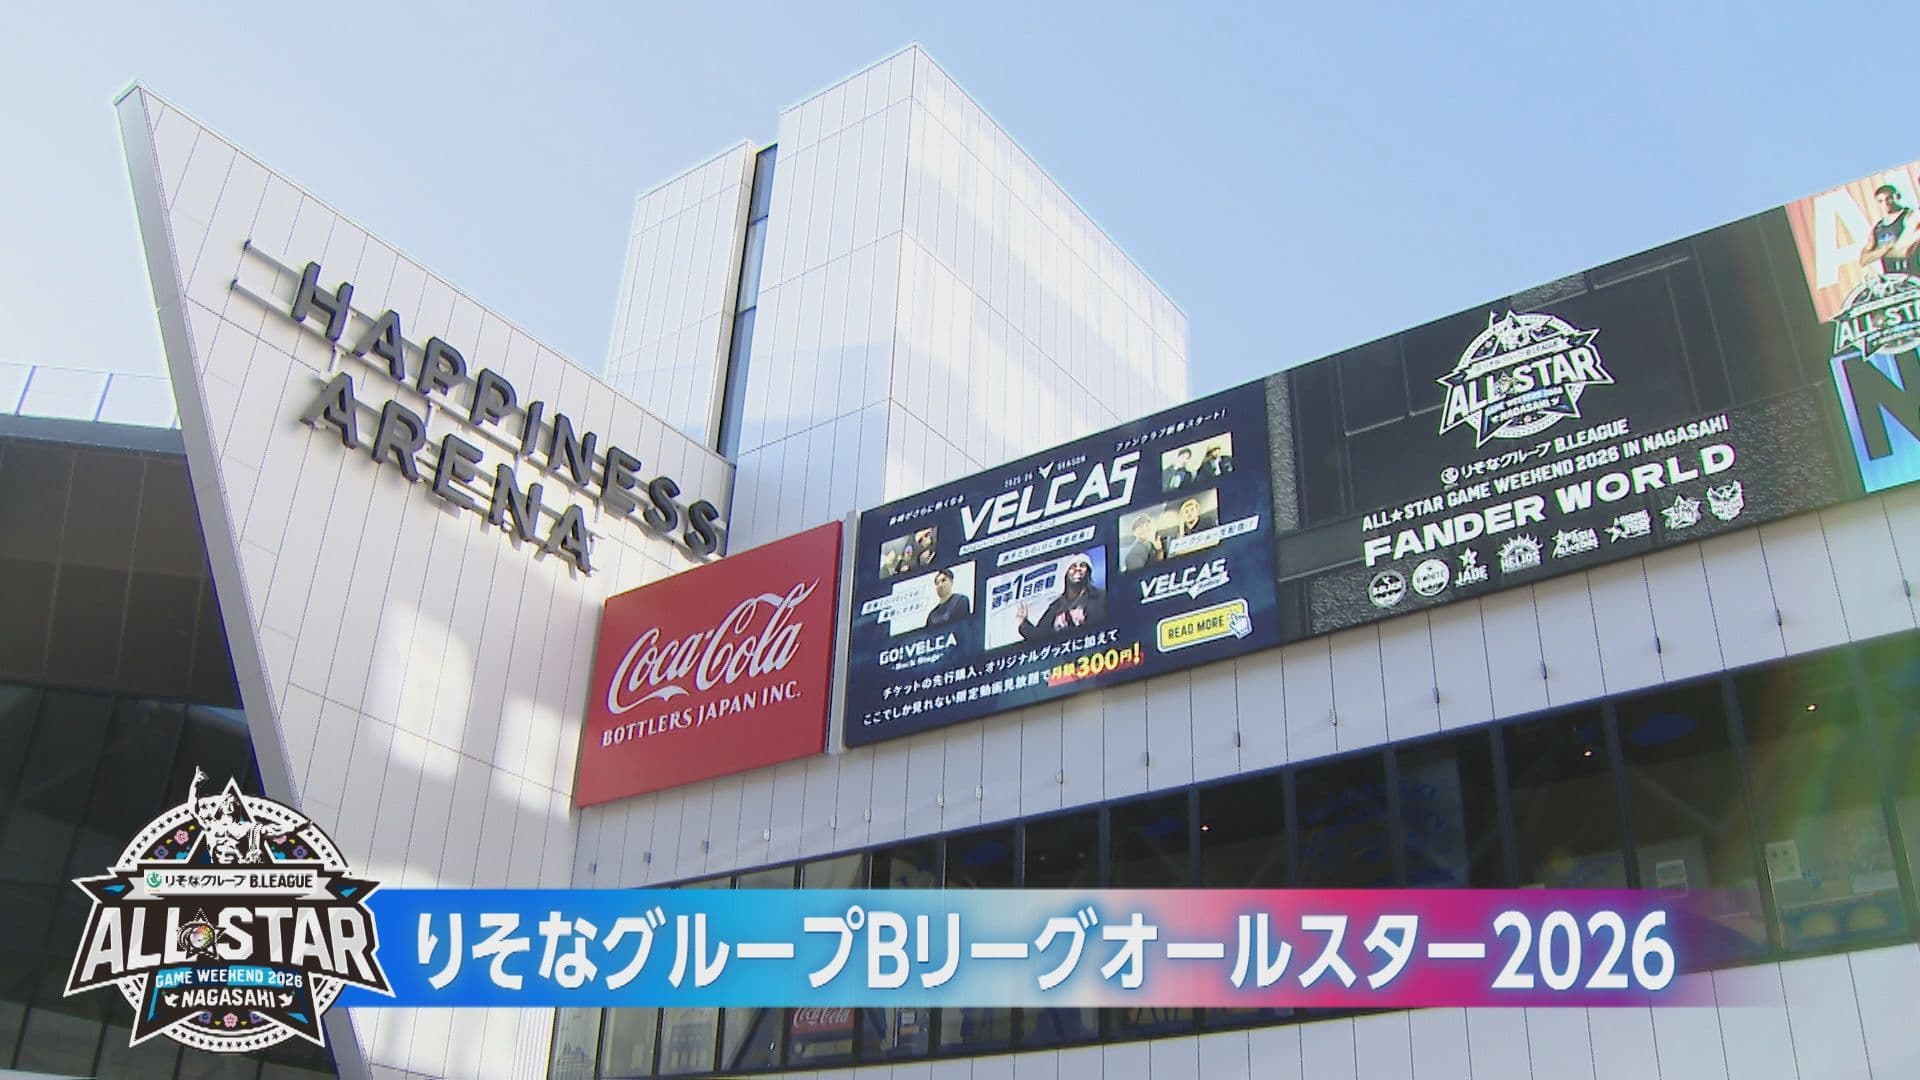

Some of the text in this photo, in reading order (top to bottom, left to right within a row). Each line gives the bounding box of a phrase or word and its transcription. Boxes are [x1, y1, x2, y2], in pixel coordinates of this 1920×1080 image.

[1885, 300, 1920, 327] ST
[291, 261, 721, 556] HAPPINESS
[1447, 375, 1507, 427] ALL
[1512, 349, 1603, 392] STAR
[300, 371, 594, 575] ARENA
[1447, 482, 1491, 508] GAME
[1576, 446, 1620, 473] 2026
[1623, 442, 1641, 458] IN
[1460, 418, 1629, 481] りそなグループ B.LEAGUE
[960, 450, 1140, 544] VELCAS
[1364, 494, 1546, 568] FANDER
[1556, 443, 1736, 515] WORLD
[1140, 558, 1227, 599] VELCAS
[607, 578, 820, 714] Coca-Cola
[1168, 615, 1224, 640] READ MORE
[601, 680, 802, 749] BOTTLERS JAPAN INC.
